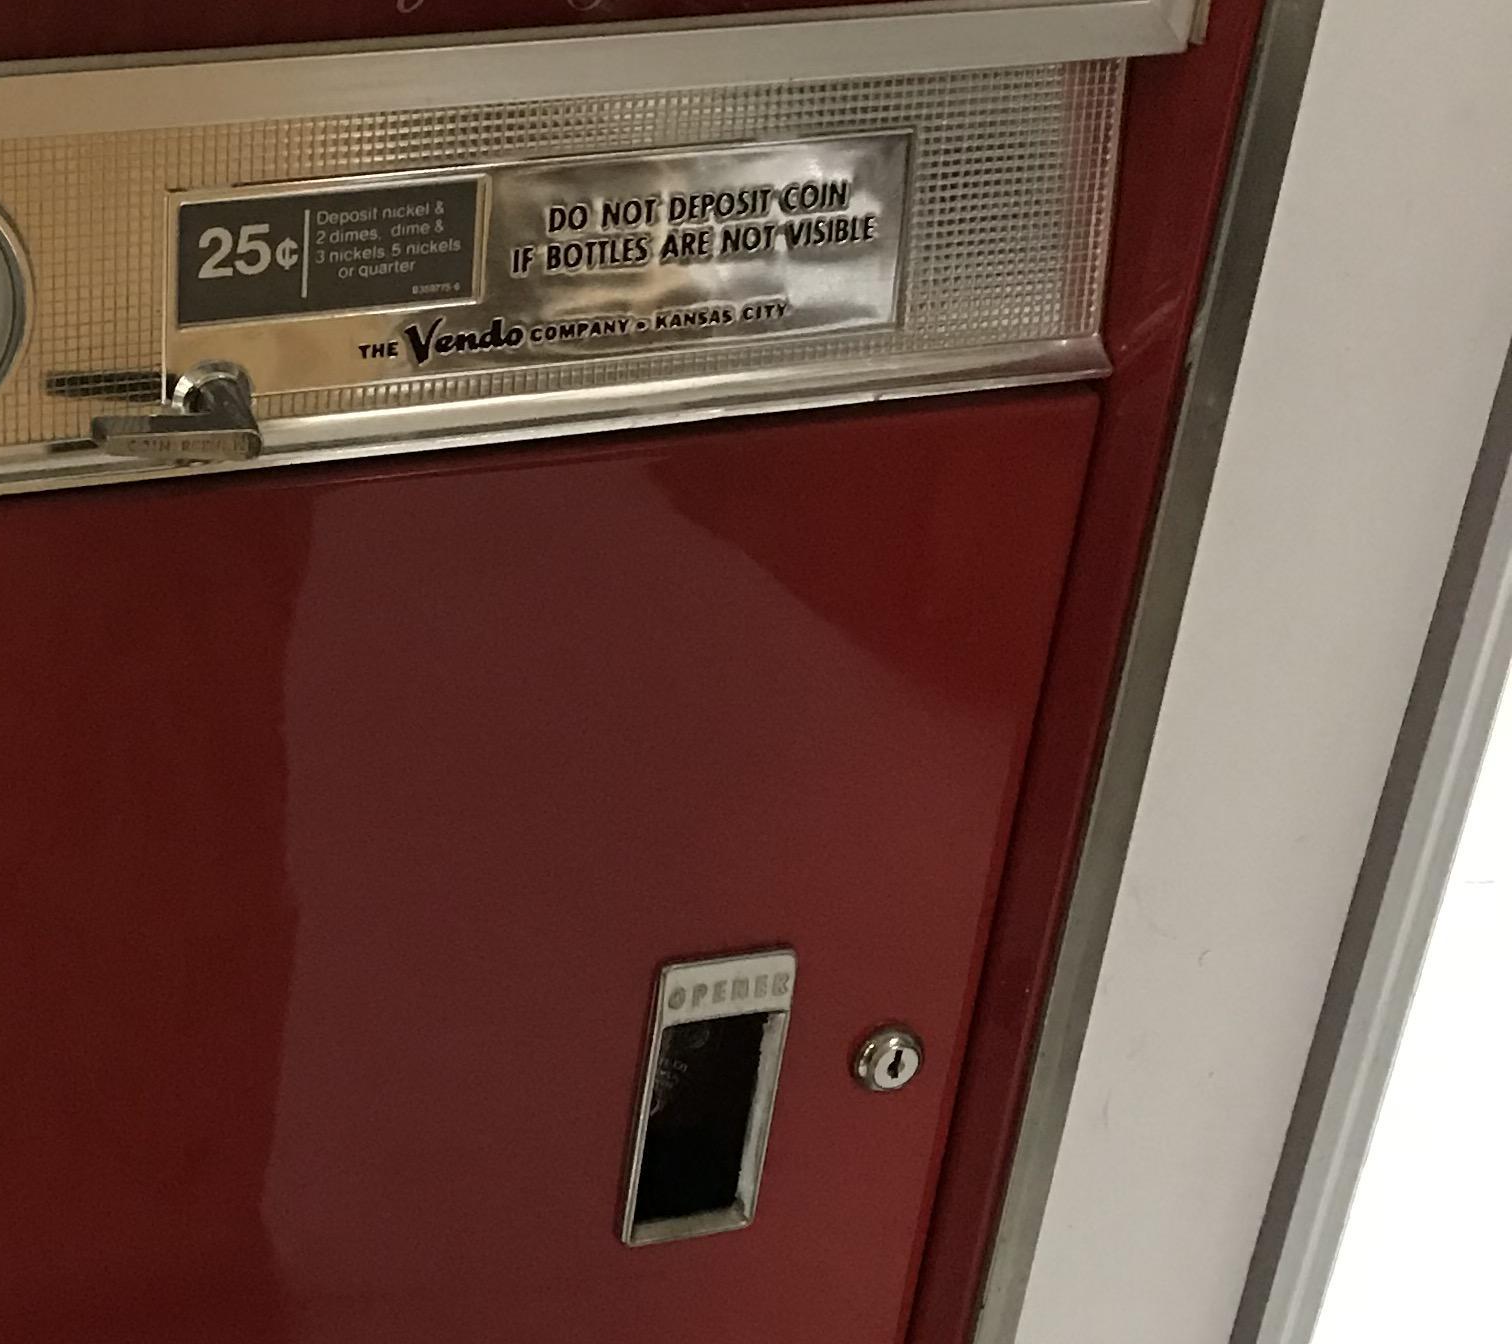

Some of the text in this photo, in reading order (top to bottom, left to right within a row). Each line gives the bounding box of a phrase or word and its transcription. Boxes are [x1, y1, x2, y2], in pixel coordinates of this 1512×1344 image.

[316, 207, 378, 226] Deposit
[382, 202, 430, 219] nickel
[547, 180, 849, 233] DO NOT DEPOSIT COIN
[197, 223, 299, 279] 25¢
[315, 230, 326, 245] 2
[391, 222, 430, 237] dime
[315, 249, 325, 264] 3
[391, 243, 401, 257] 5
[406, 238, 461, 254] nickels
[512, 214, 877, 274] IF BOTTLES ARE NOT VISIBLE
[338, 260, 416, 279] or quarter
[358, 302, 787, 366] THE Vendo COMPANY KANSAS CITY
[668, 973, 790, 1010] OPENER
